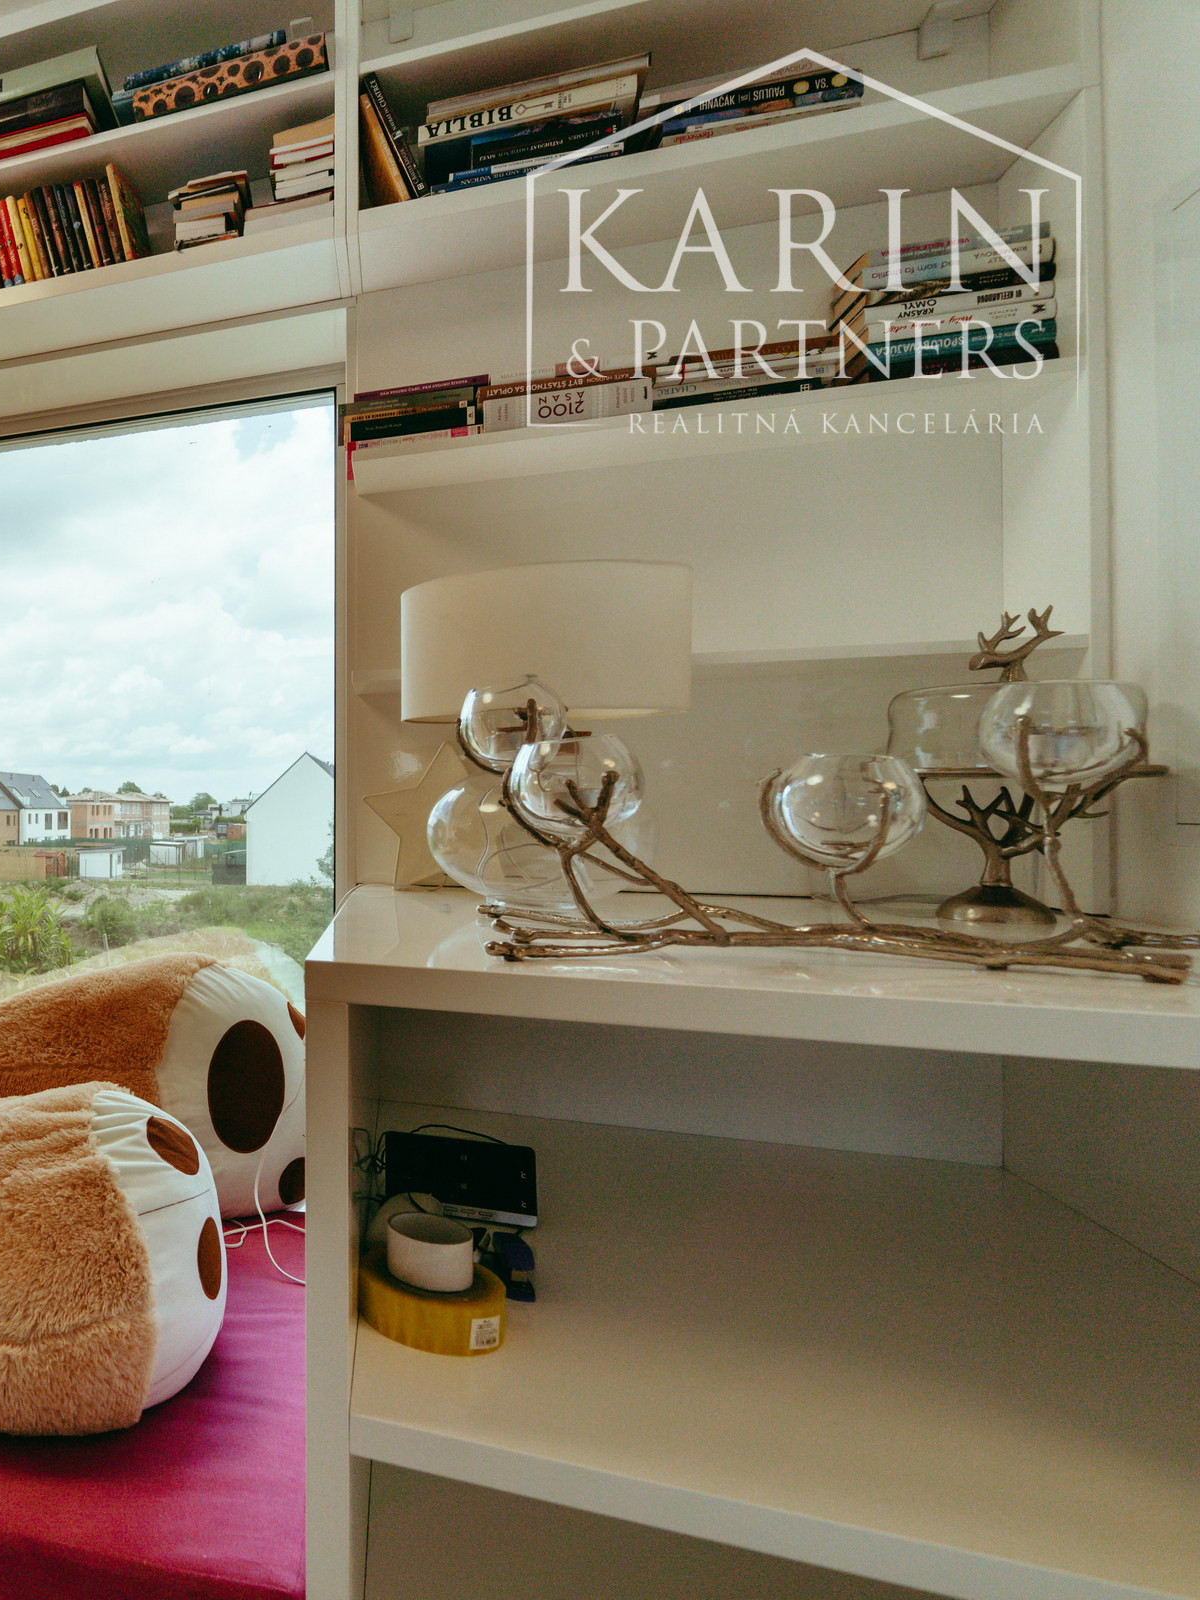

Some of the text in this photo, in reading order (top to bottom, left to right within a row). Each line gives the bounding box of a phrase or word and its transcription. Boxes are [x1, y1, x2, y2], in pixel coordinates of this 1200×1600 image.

[815, 78, 829, 89] VS.
[753, 86, 785, 101] PAULUS
[426, 104, 513, 139] BIBLIA
[505, 170, 521, 178] AND
[460, 175, 492, 186] VATICAN
[918, 263, 938, 272] som
[901, 299, 937, 311] OMYL
[897, 307, 935, 319] KRÁSNY
[571, 377, 583, 387] BYŤ
[586, 374, 612, 383] HUDSON
[486, 386, 514, 398] OPLATÍ
[514, 384, 524, 393] SA
[526, 379, 569, 393] ŠŤASTNOU
[538, 391, 585, 406] ÁSAN
[538, 400, 585, 419] 2100
